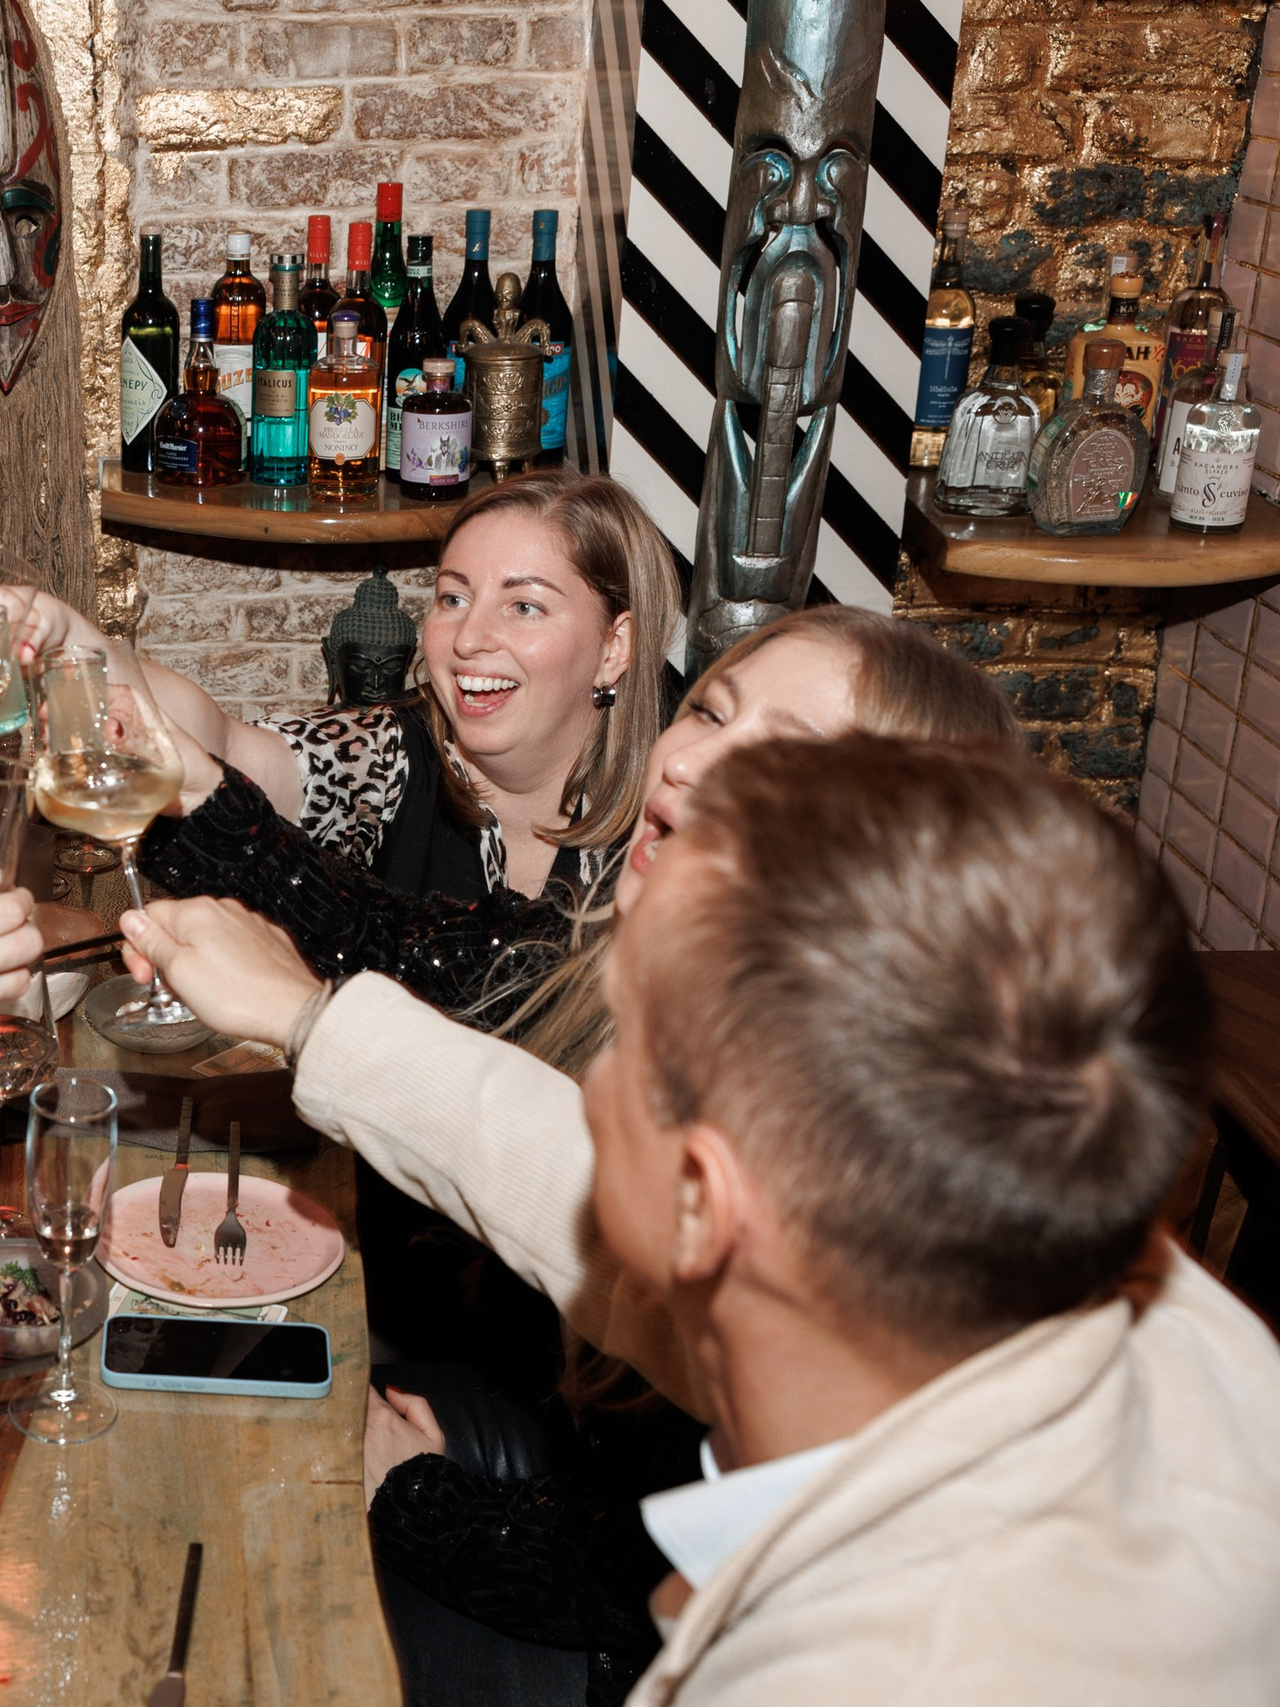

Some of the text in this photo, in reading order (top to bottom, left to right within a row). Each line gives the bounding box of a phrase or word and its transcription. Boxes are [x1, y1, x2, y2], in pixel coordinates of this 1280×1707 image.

[419, 419, 469, 431] BERKSHIRE
[977, 451, 1028, 462] ANTIGUA
[985, 458, 1017, 470] CRUZ
[1194, 462, 1240, 470] BACANORA
